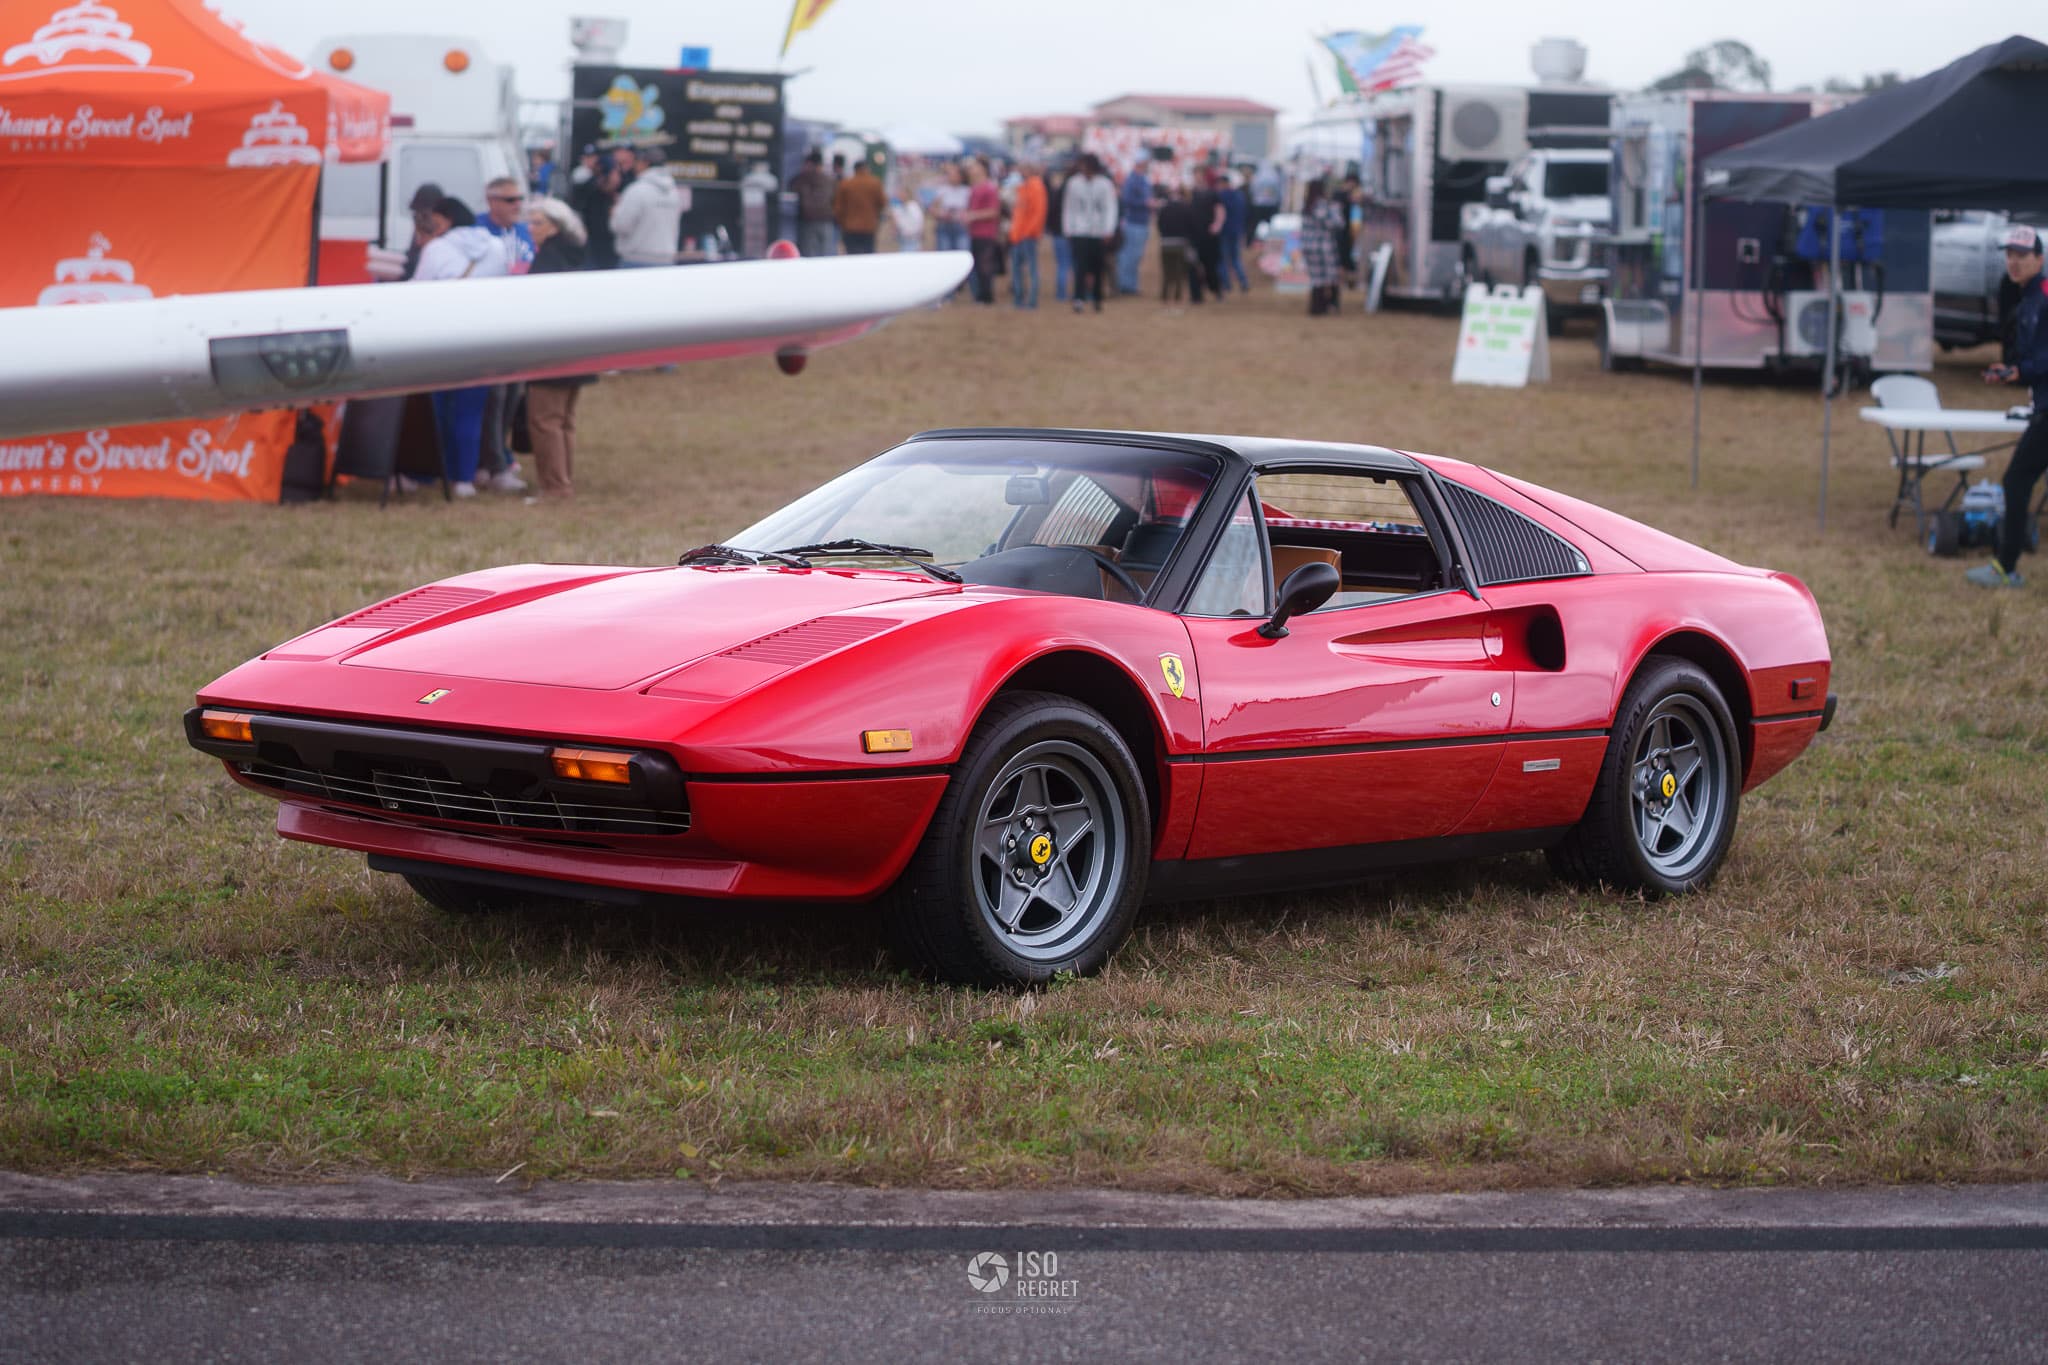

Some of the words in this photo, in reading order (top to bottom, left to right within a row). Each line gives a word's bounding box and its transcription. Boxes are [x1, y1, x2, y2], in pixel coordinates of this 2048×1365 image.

[67, 104, 135, 140] Sweet
[137, 106, 193, 144] Spot
[10, 139, 88, 151] BAKERY
[74, 429, 171, 475] Sweet
[177, 429, 256, 482] Spot
[0, 475, 103, 493] AKERY
